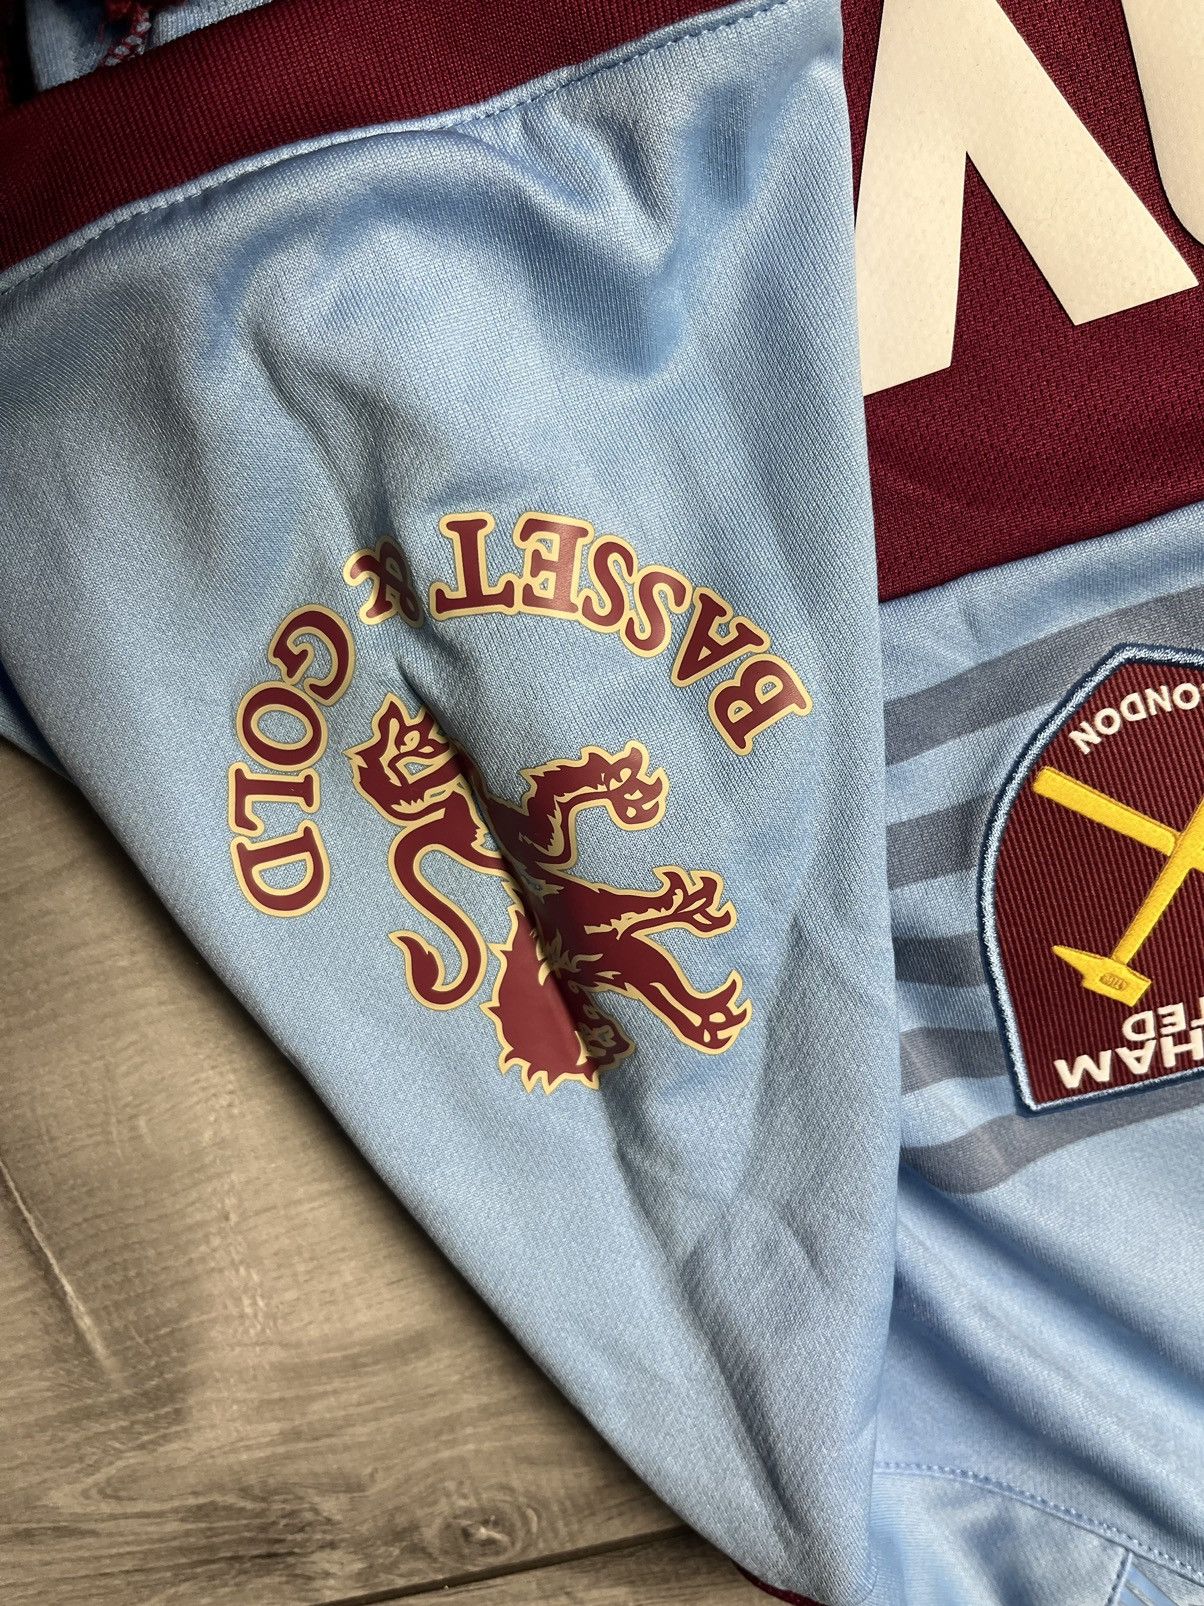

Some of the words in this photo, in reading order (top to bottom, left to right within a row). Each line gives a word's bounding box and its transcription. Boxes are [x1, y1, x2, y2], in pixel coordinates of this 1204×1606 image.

[343, 537, 425, 628] &
[429, 511, 813, 757] BASSET
[228, 604, 355, 918] GOLD
[1068, 682, 1204, 755] ONDON
[1053, 1028, 1204, 1089] HAM
